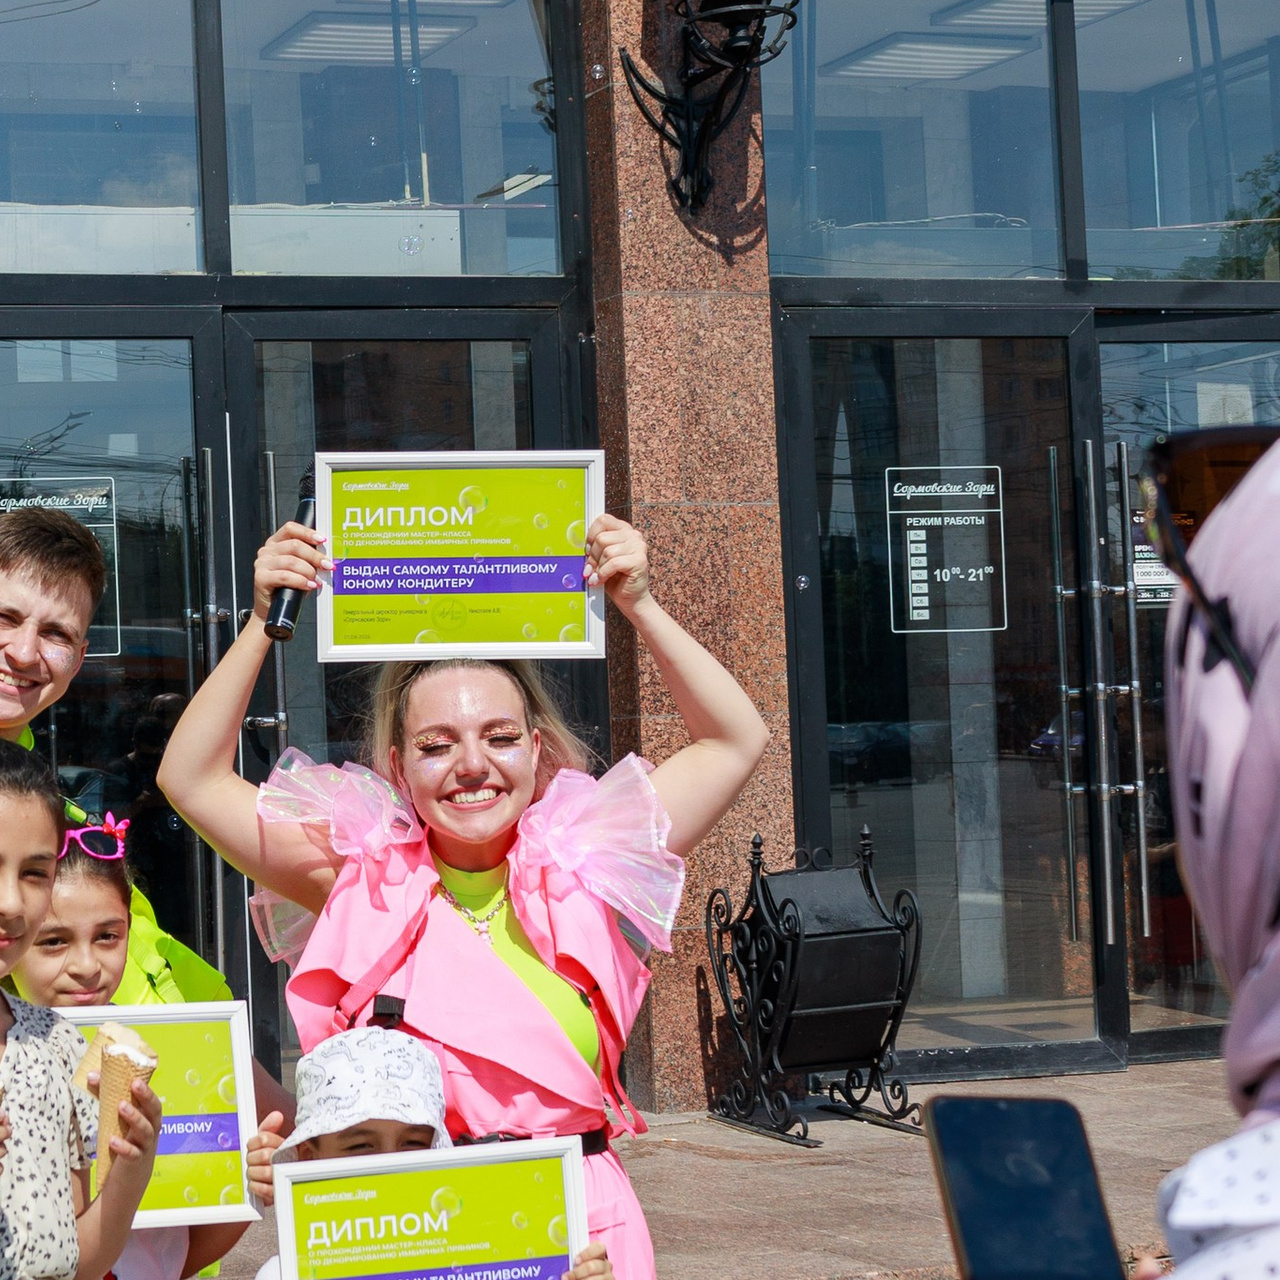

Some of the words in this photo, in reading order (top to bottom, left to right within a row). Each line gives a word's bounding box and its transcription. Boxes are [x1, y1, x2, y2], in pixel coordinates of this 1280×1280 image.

[893, 482, 962, 500] Сормовские
[965, 481, 995, 499] Зори
[73, 494, 107, 512] Зори
[342, 506, 473, 530] ДИПЛОМ
[906, 517, 942, 526] РЕЖИМ
[944, 516, 985, 526] РАБОТЫ
[343, 565, 389, 576] ВЫДАН
[393, 564, 449, 575] САМОМУ
[452, 563, 558, 575] ТАЛАНТЛИВОМУ
[343, 579, 394, 590] ЮНОМУ
[397, 578, 474, 591] КОНДИТЕРУ
[159, 1121, 213, 1135] ЛИВОМУ
[307, 1209, 449, 1250] ДИПЛОМ
